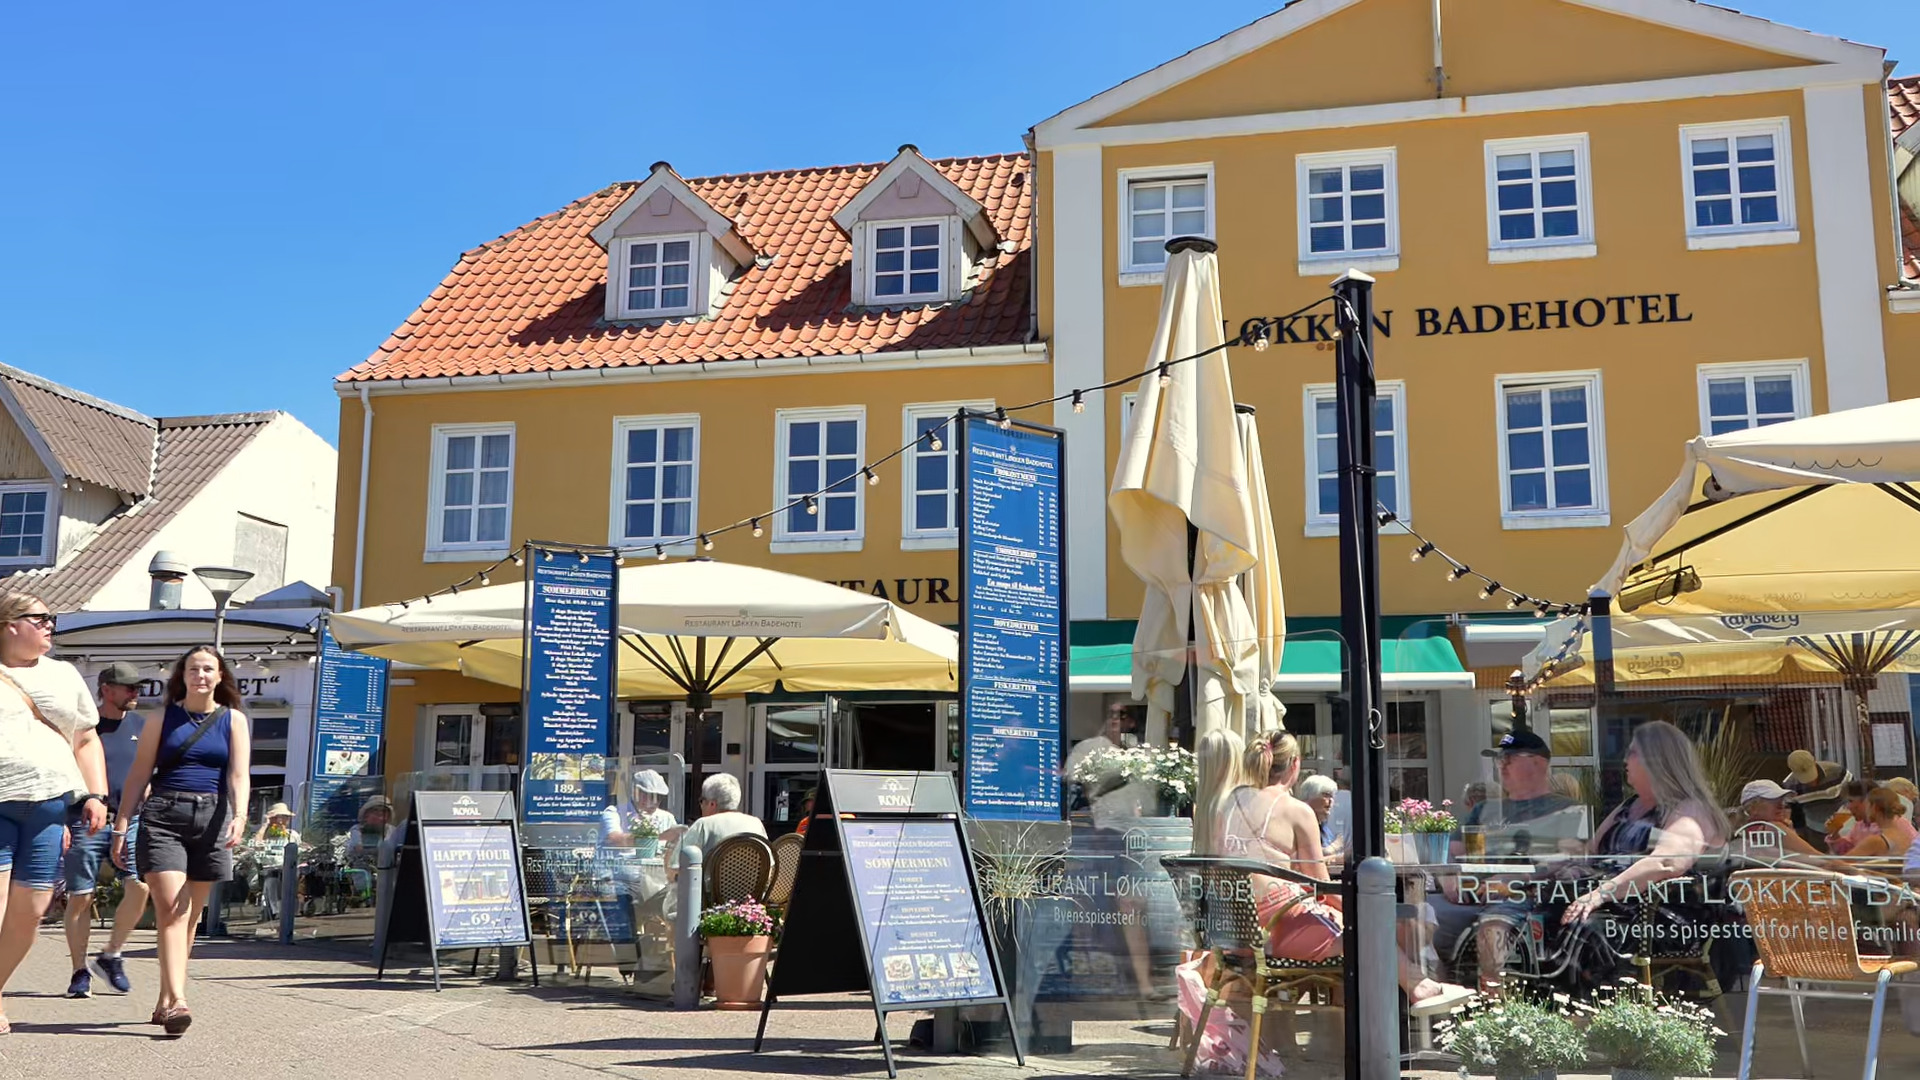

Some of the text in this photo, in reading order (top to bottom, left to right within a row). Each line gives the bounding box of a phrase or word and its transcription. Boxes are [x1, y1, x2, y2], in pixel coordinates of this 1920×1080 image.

[1415, 293, 1693, 337] BADEHOTEL
[542, 585, 607, 597] SOMMERBRUNCH
[684, 619, 730, 627] RESTAURANT
[761, 620, 802, 628] BADEHOTEL
[880, 795, 915, 806] ROYAL
[452, 807, 481, 816] ROYAL
[433, 849, 511, 861] HAPPY HOUR
[864, 857, 952, 869] SOMMERMENU
[1457, 875, 1692, 904] RESTAURANT
[1702, 874, 1853, 906] LØKKEN
[470, 912, 501, 928] 69,-
[1085, 908, 1135, 928] spisested
[1605, 919, 1665, 944] Byens
[1670, 919, 1764, 945] spisested
[1769, 918, 1799, 939] for
[1804, 919, 1848, 940] hele
